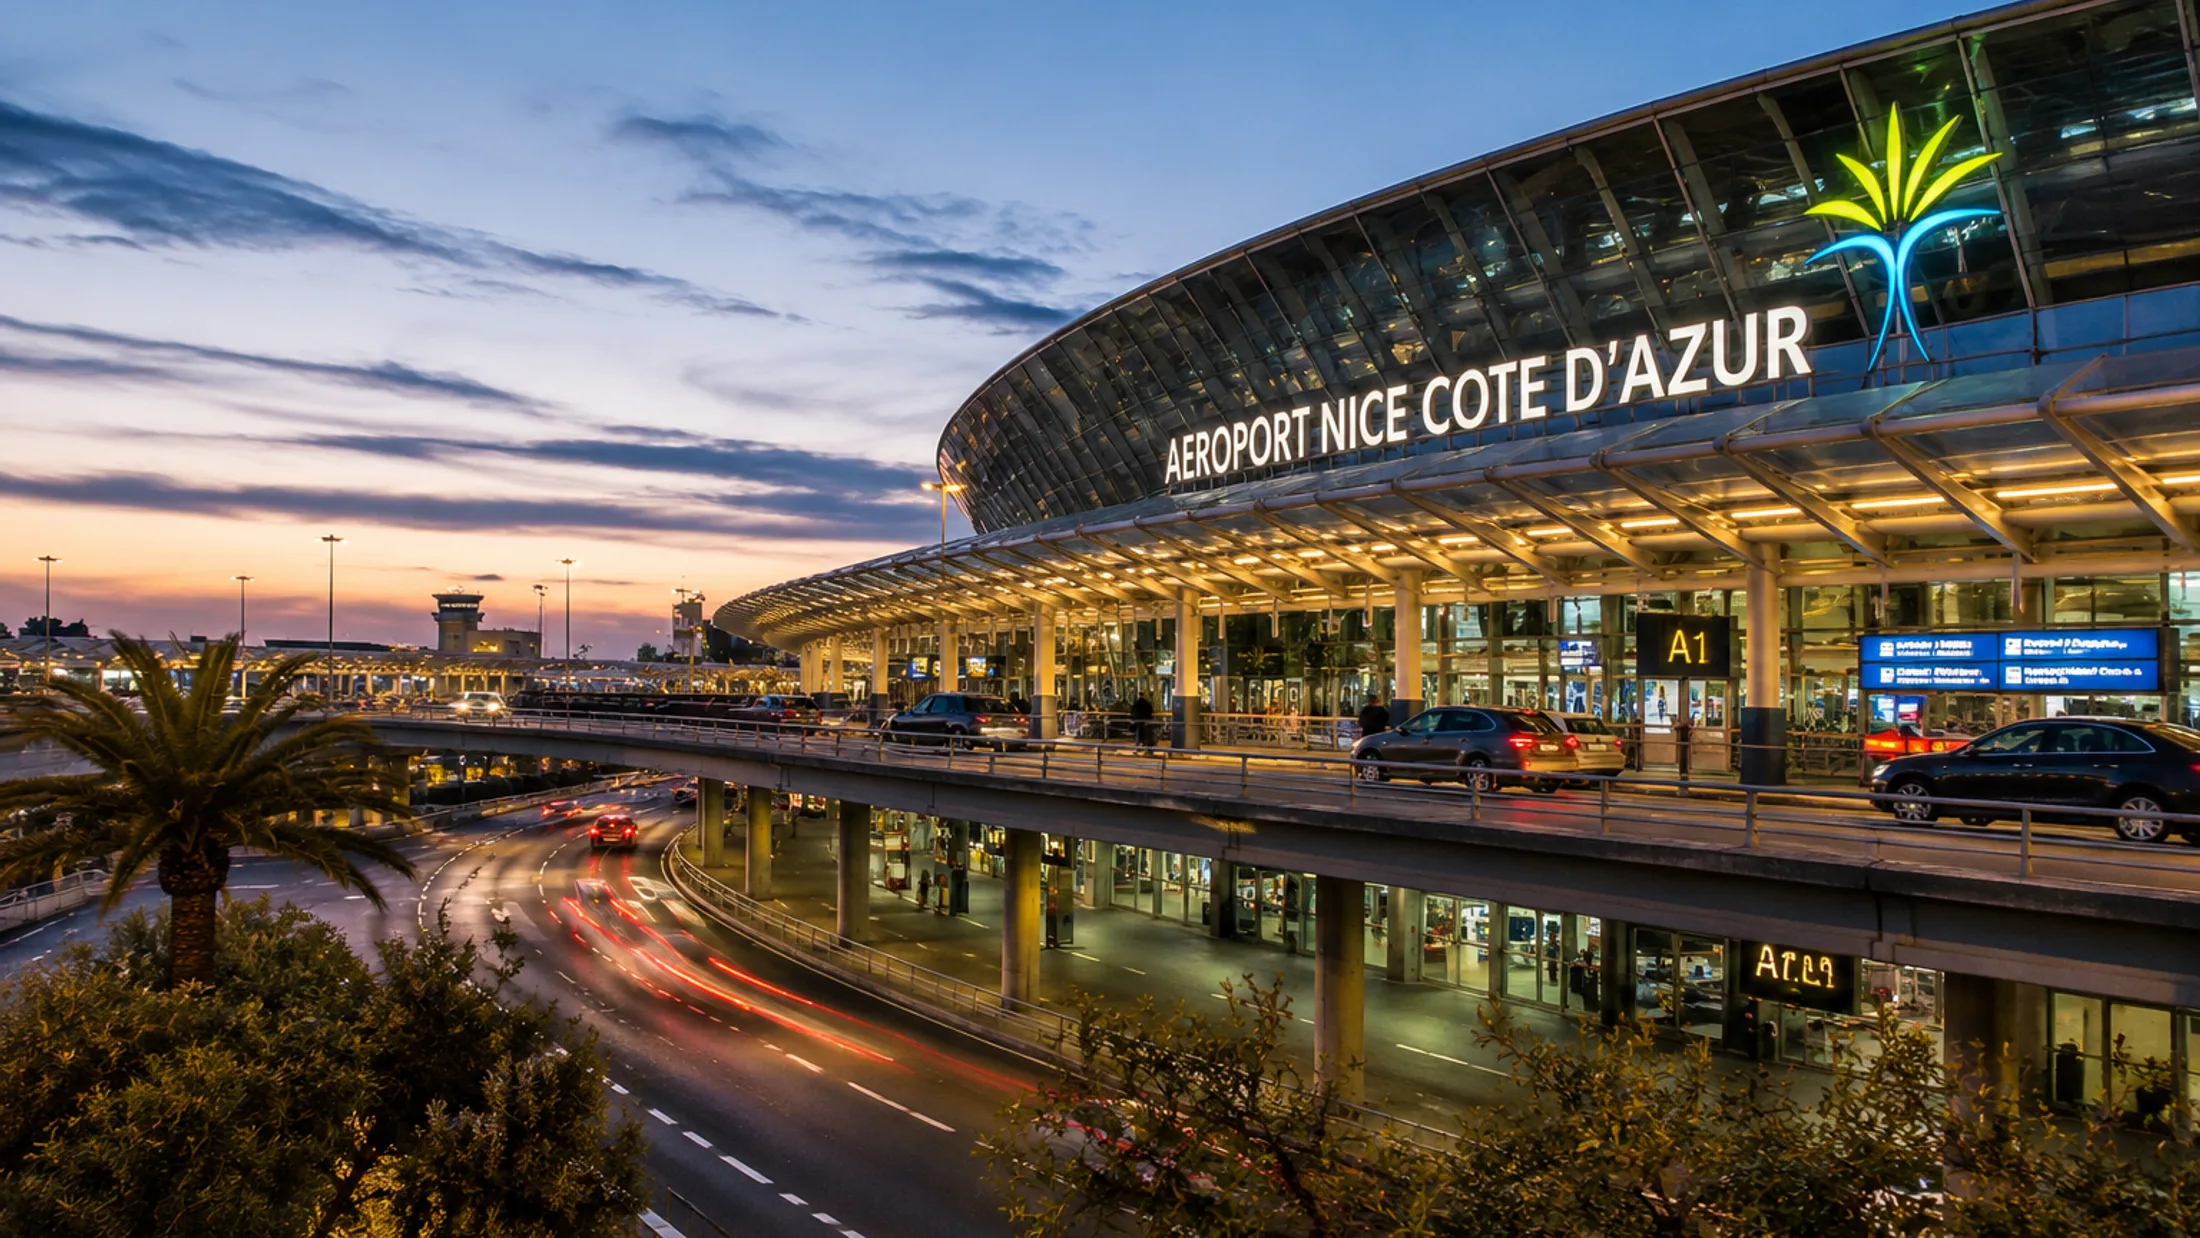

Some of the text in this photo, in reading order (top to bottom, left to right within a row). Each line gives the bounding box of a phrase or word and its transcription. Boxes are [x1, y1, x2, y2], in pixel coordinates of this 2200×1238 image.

[1164, 305, 1813, 485] AEROPORT NICE COTE D'AZUR
[1667, 629, 1709, 665] A1
